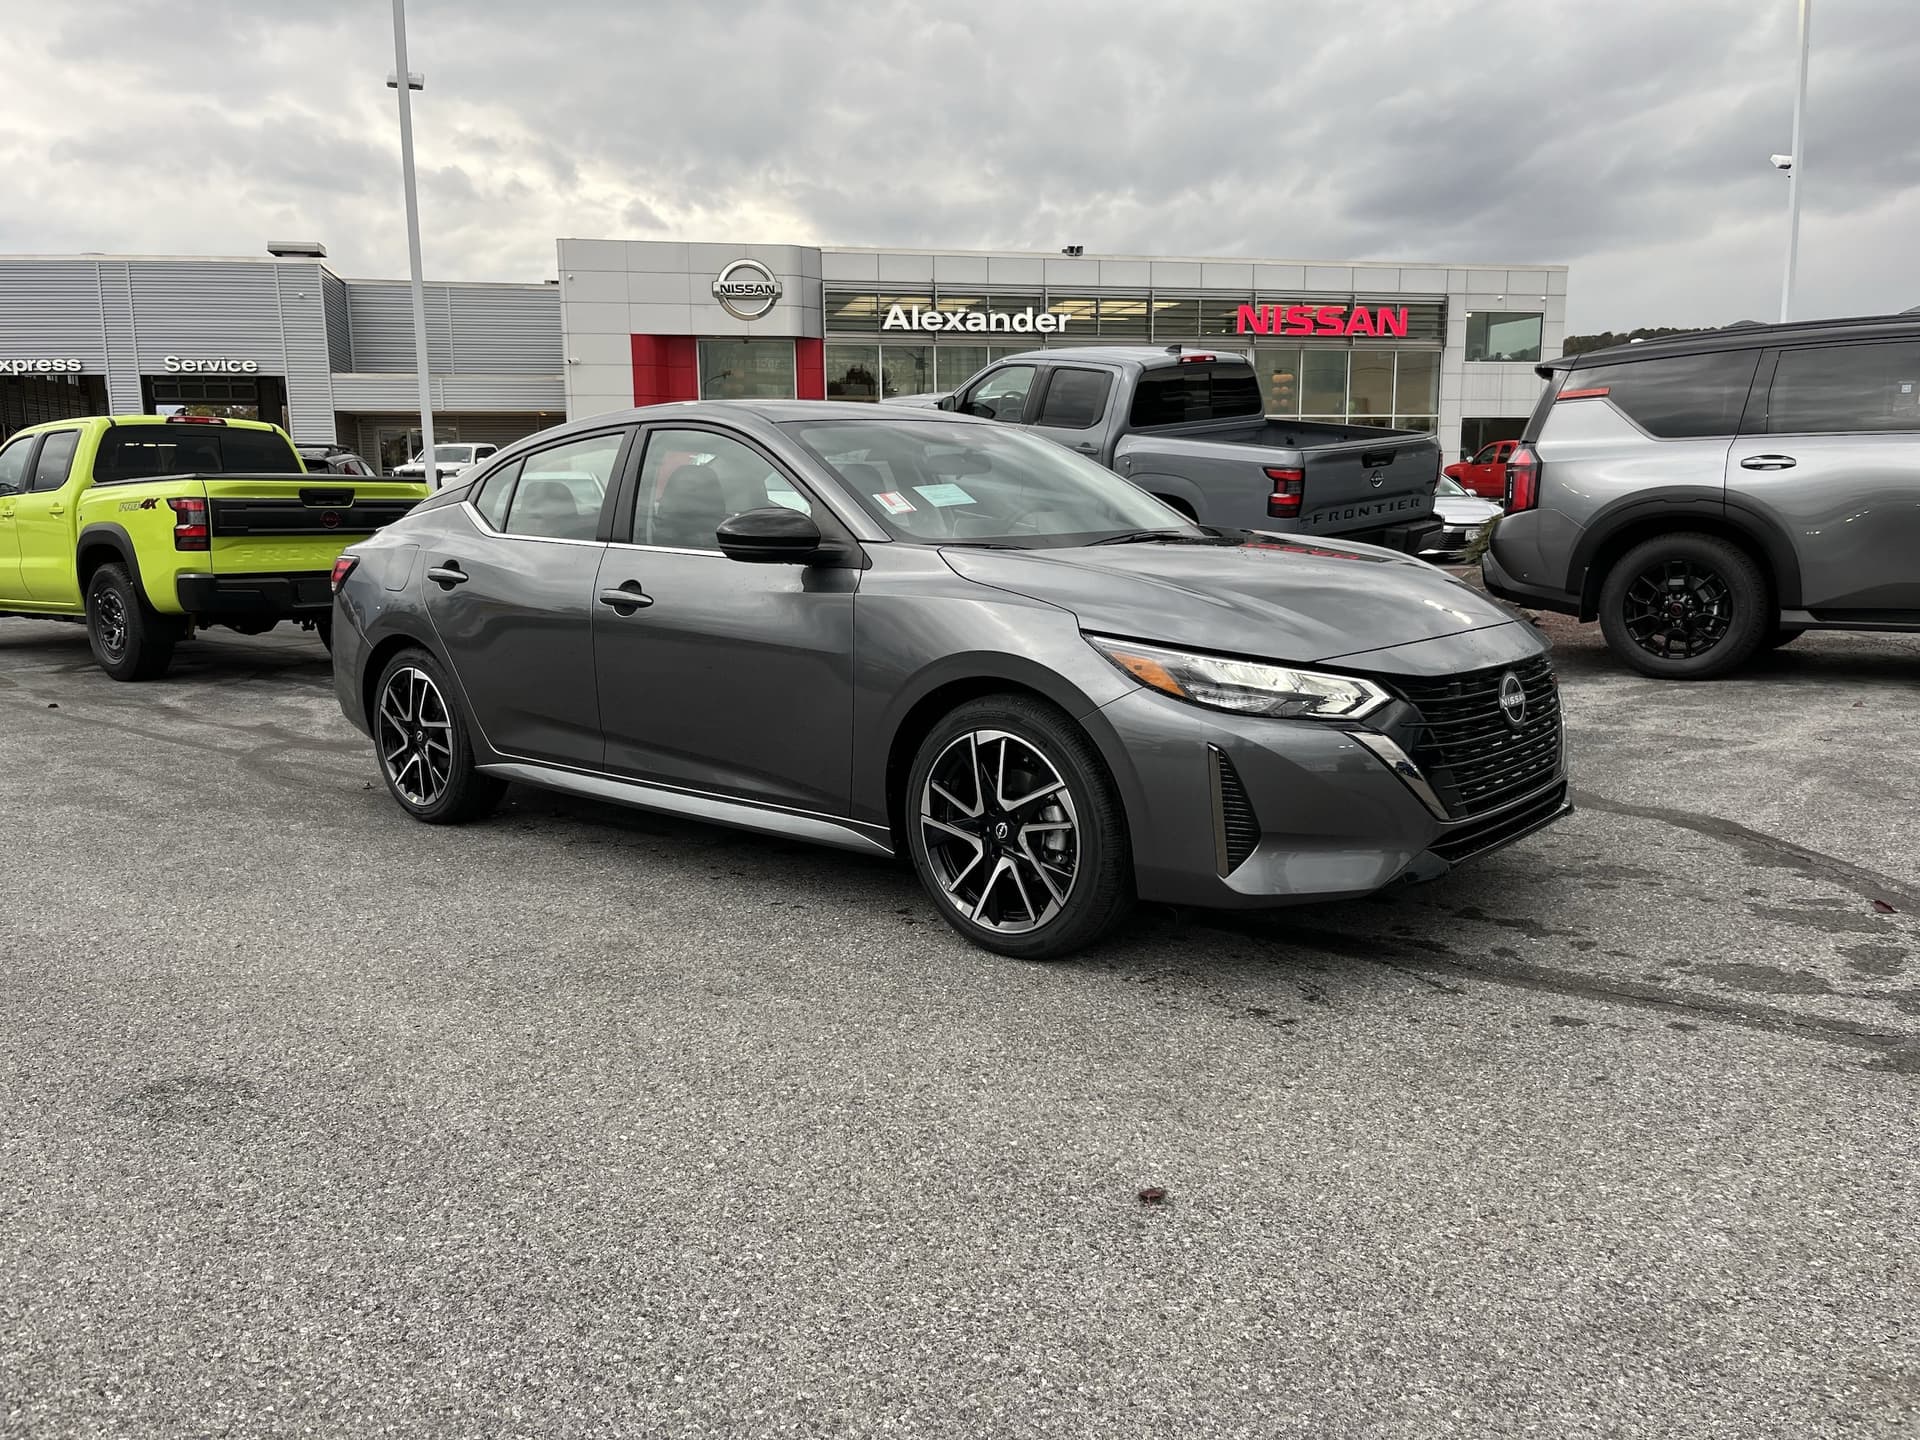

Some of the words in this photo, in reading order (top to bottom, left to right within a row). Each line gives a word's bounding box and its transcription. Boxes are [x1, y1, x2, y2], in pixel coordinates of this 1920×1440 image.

[720, 284, 776, 294] NISSAN
[882, 304, 1072, 333] Alexander
[1236, 304, 1409, 337] NISSAN
[164, 355, 258, 372] Service
[1312, 498, 1420, 525] FRONTIER
